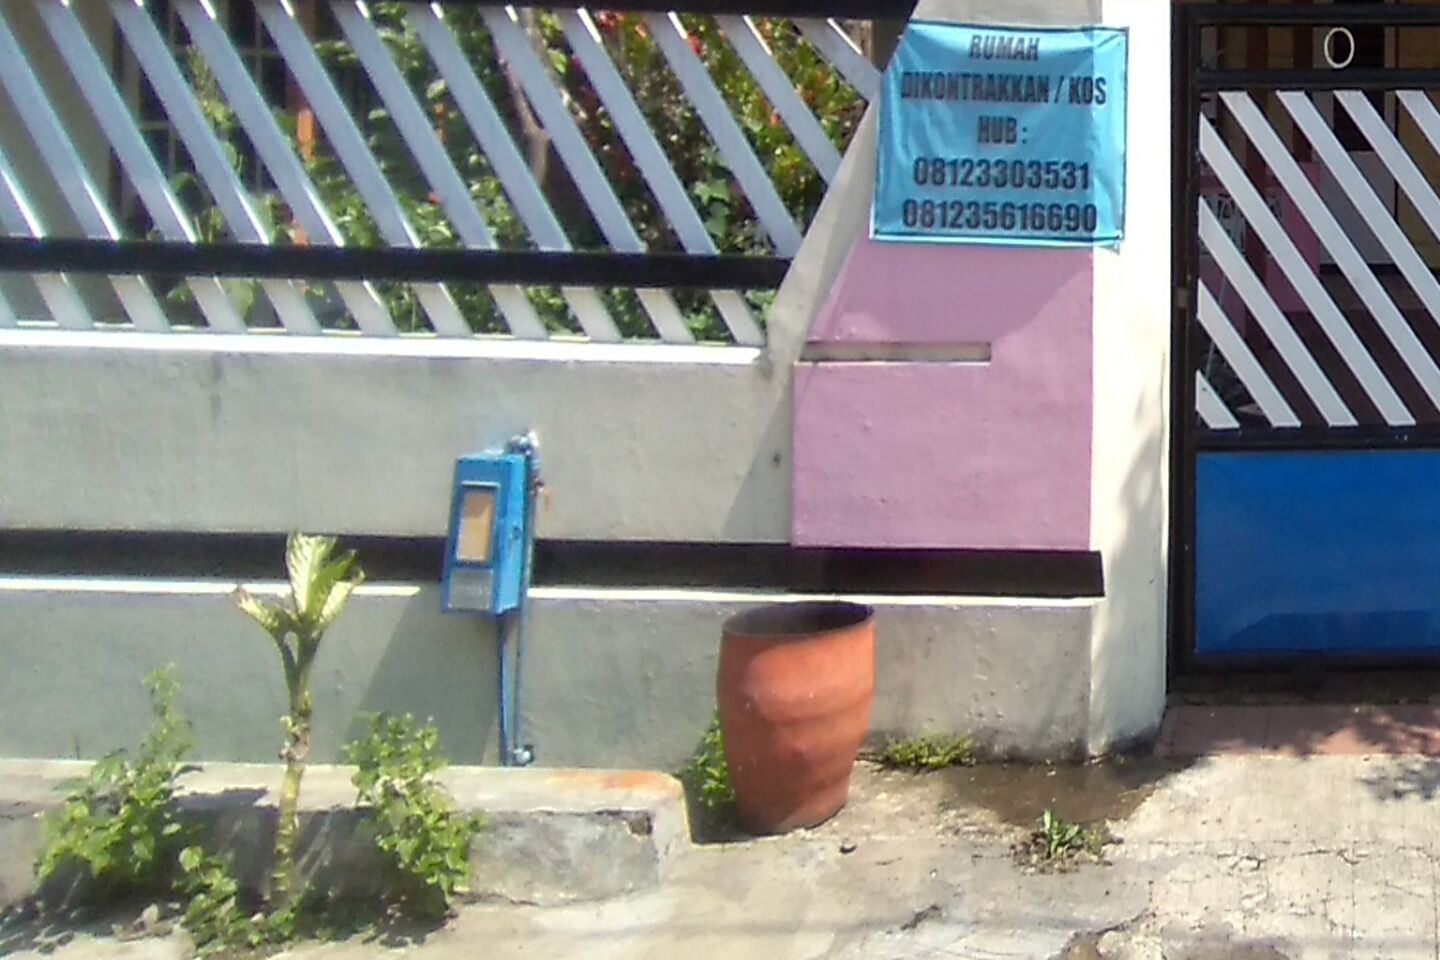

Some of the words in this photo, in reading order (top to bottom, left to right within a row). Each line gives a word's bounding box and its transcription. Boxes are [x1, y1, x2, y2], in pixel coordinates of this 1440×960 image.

[969, 34, 1039, 62] RUMAH
[901, 71, 1050, 103] DIKONTRAKKAN
[1068, 76, 1106, 105] KOS
[914, 157, 1089, 190] 08123303531
[903, 199, 1097, 232] 081235616690
